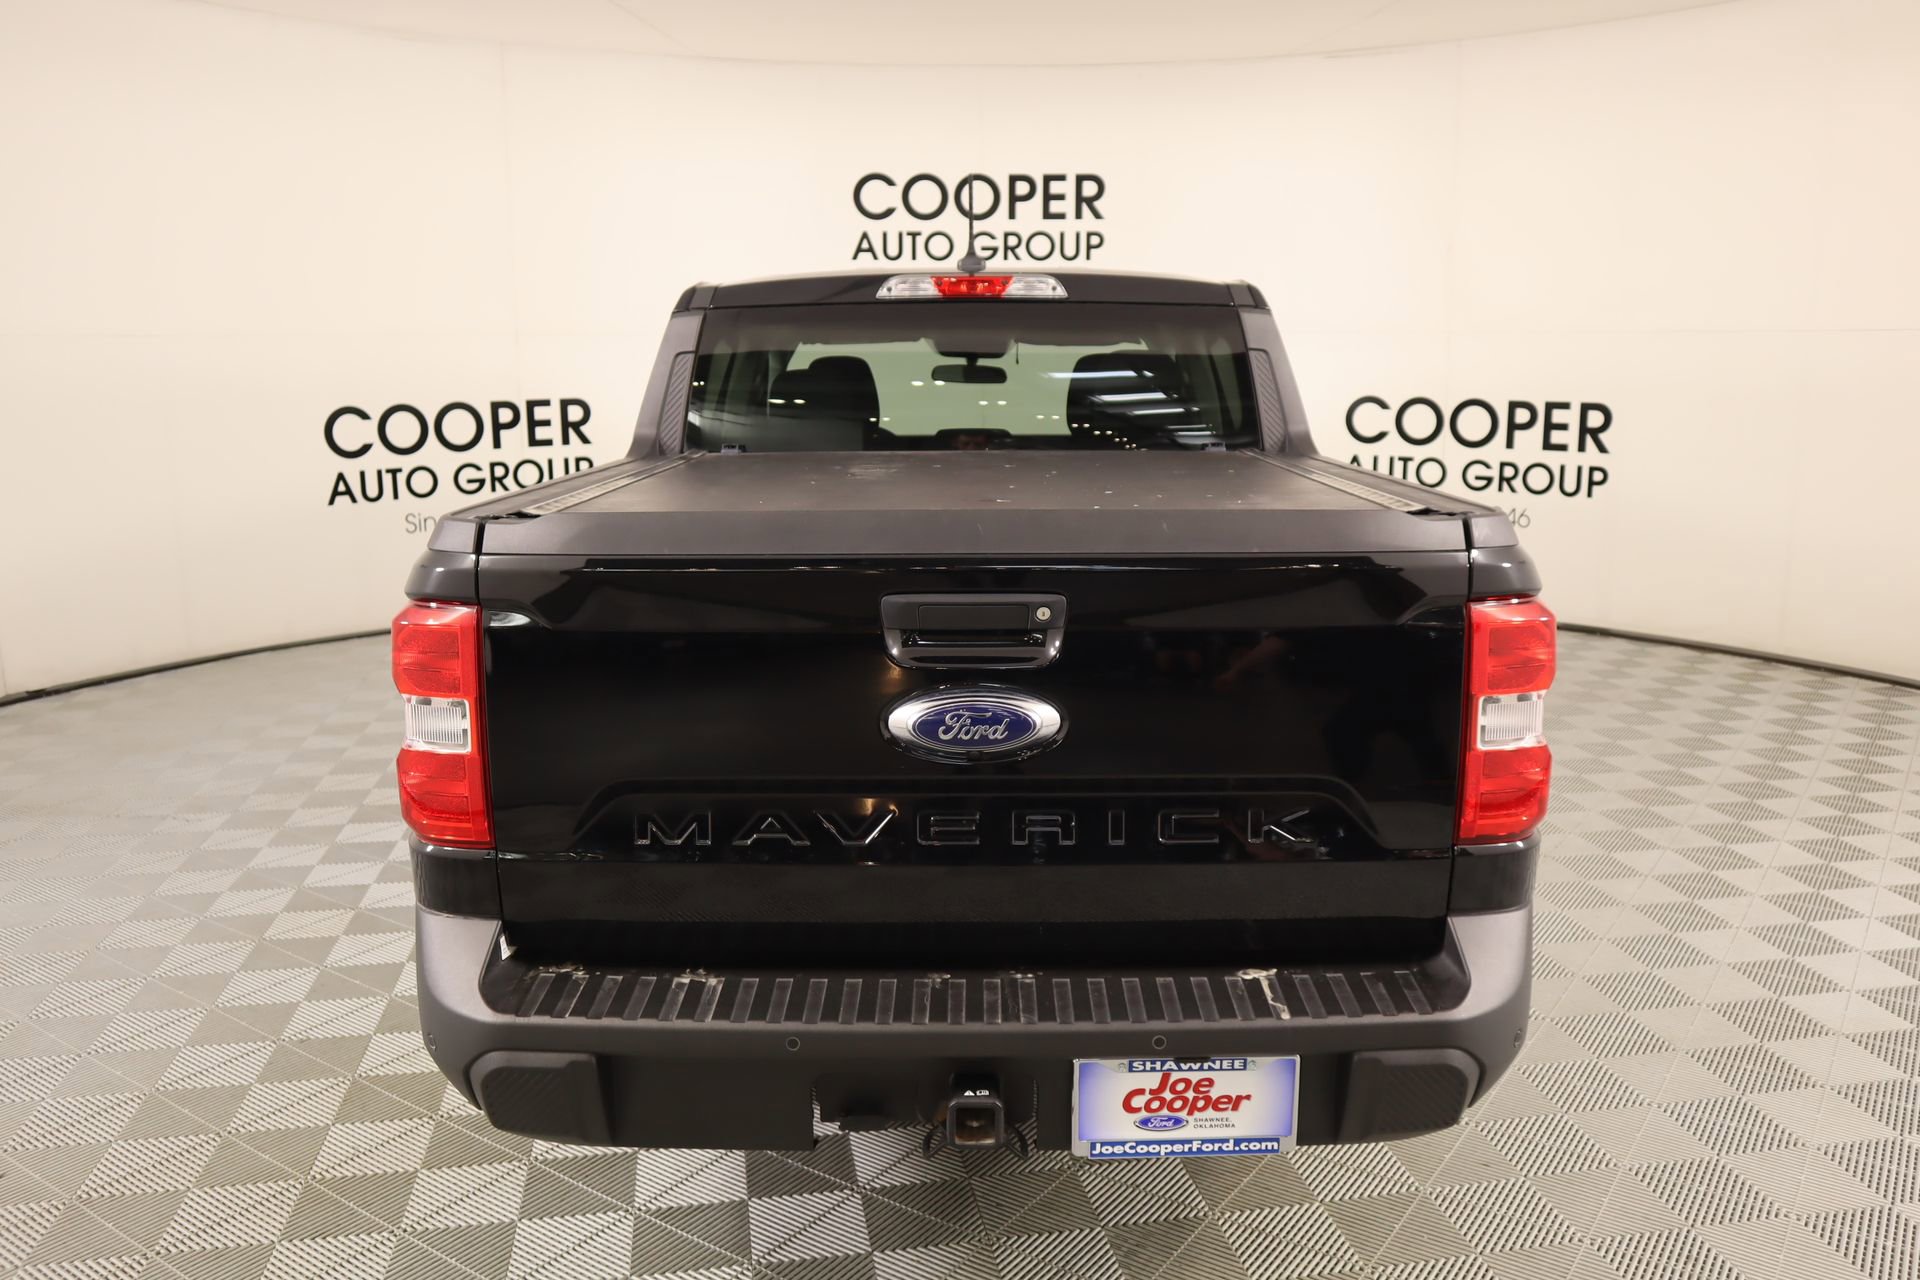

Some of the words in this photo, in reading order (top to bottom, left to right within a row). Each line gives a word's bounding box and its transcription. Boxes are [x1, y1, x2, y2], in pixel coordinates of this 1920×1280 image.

[853, 173, 1106, 220] COOPER
[852, 231, 954, 261] AUTO
[973, 231, 1105, 261] GROUP
[324, 398, 591, 459] COOPER
[1345, 395, 1613, 454] COOPER
[328, 465, 438, 506] AUTO
[1462, 459, 1609, 498] GROUP
[938, 710, 1010, 740] Ford
[634, 808, 1315, 846] MAVERICK
[1131, 1059, 1245, 1072] SHAWNEE
[1148, 1072, 1215, 1096] Joe
[1122, 1088, 1251, 1116] Cooper
[1147, 1116, 1174, 1128] Ford
[1091, 1139, 1279, 1156] JoeCooperFord.com
